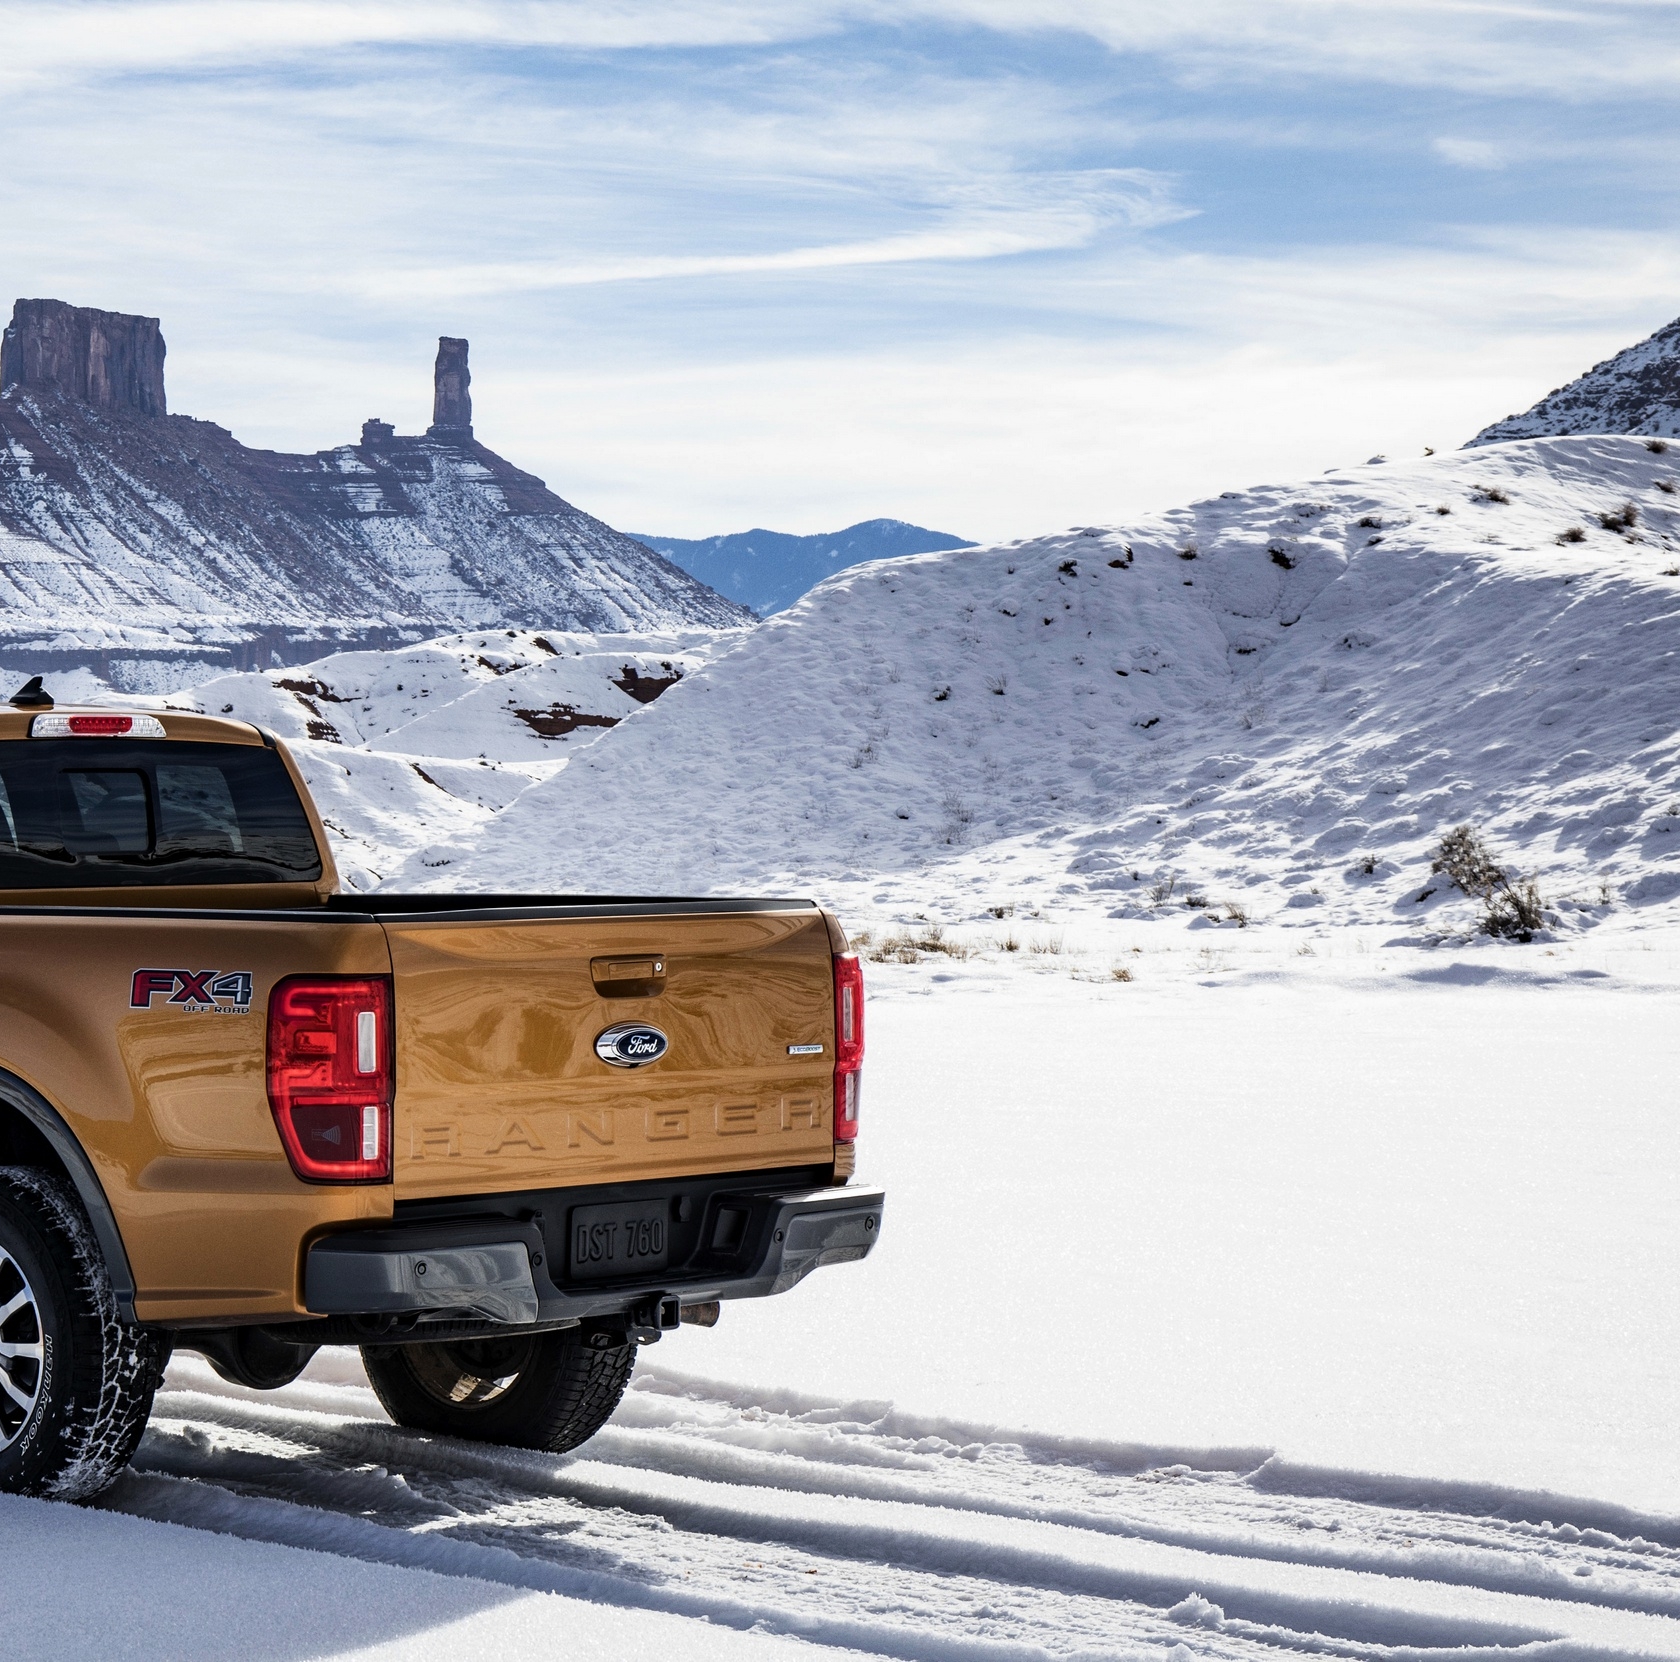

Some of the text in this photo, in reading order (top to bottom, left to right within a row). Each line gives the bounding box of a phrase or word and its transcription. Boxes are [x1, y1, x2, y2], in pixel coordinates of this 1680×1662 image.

[129, 968, 252, 1009] FX4
[214, 1006, 250, 1014] ROAD
[627, 1035, 658, 1054] Ford
[411, 1097, 821, 1160] RANGER
[576, 1219, 663, 1264] DST 760
